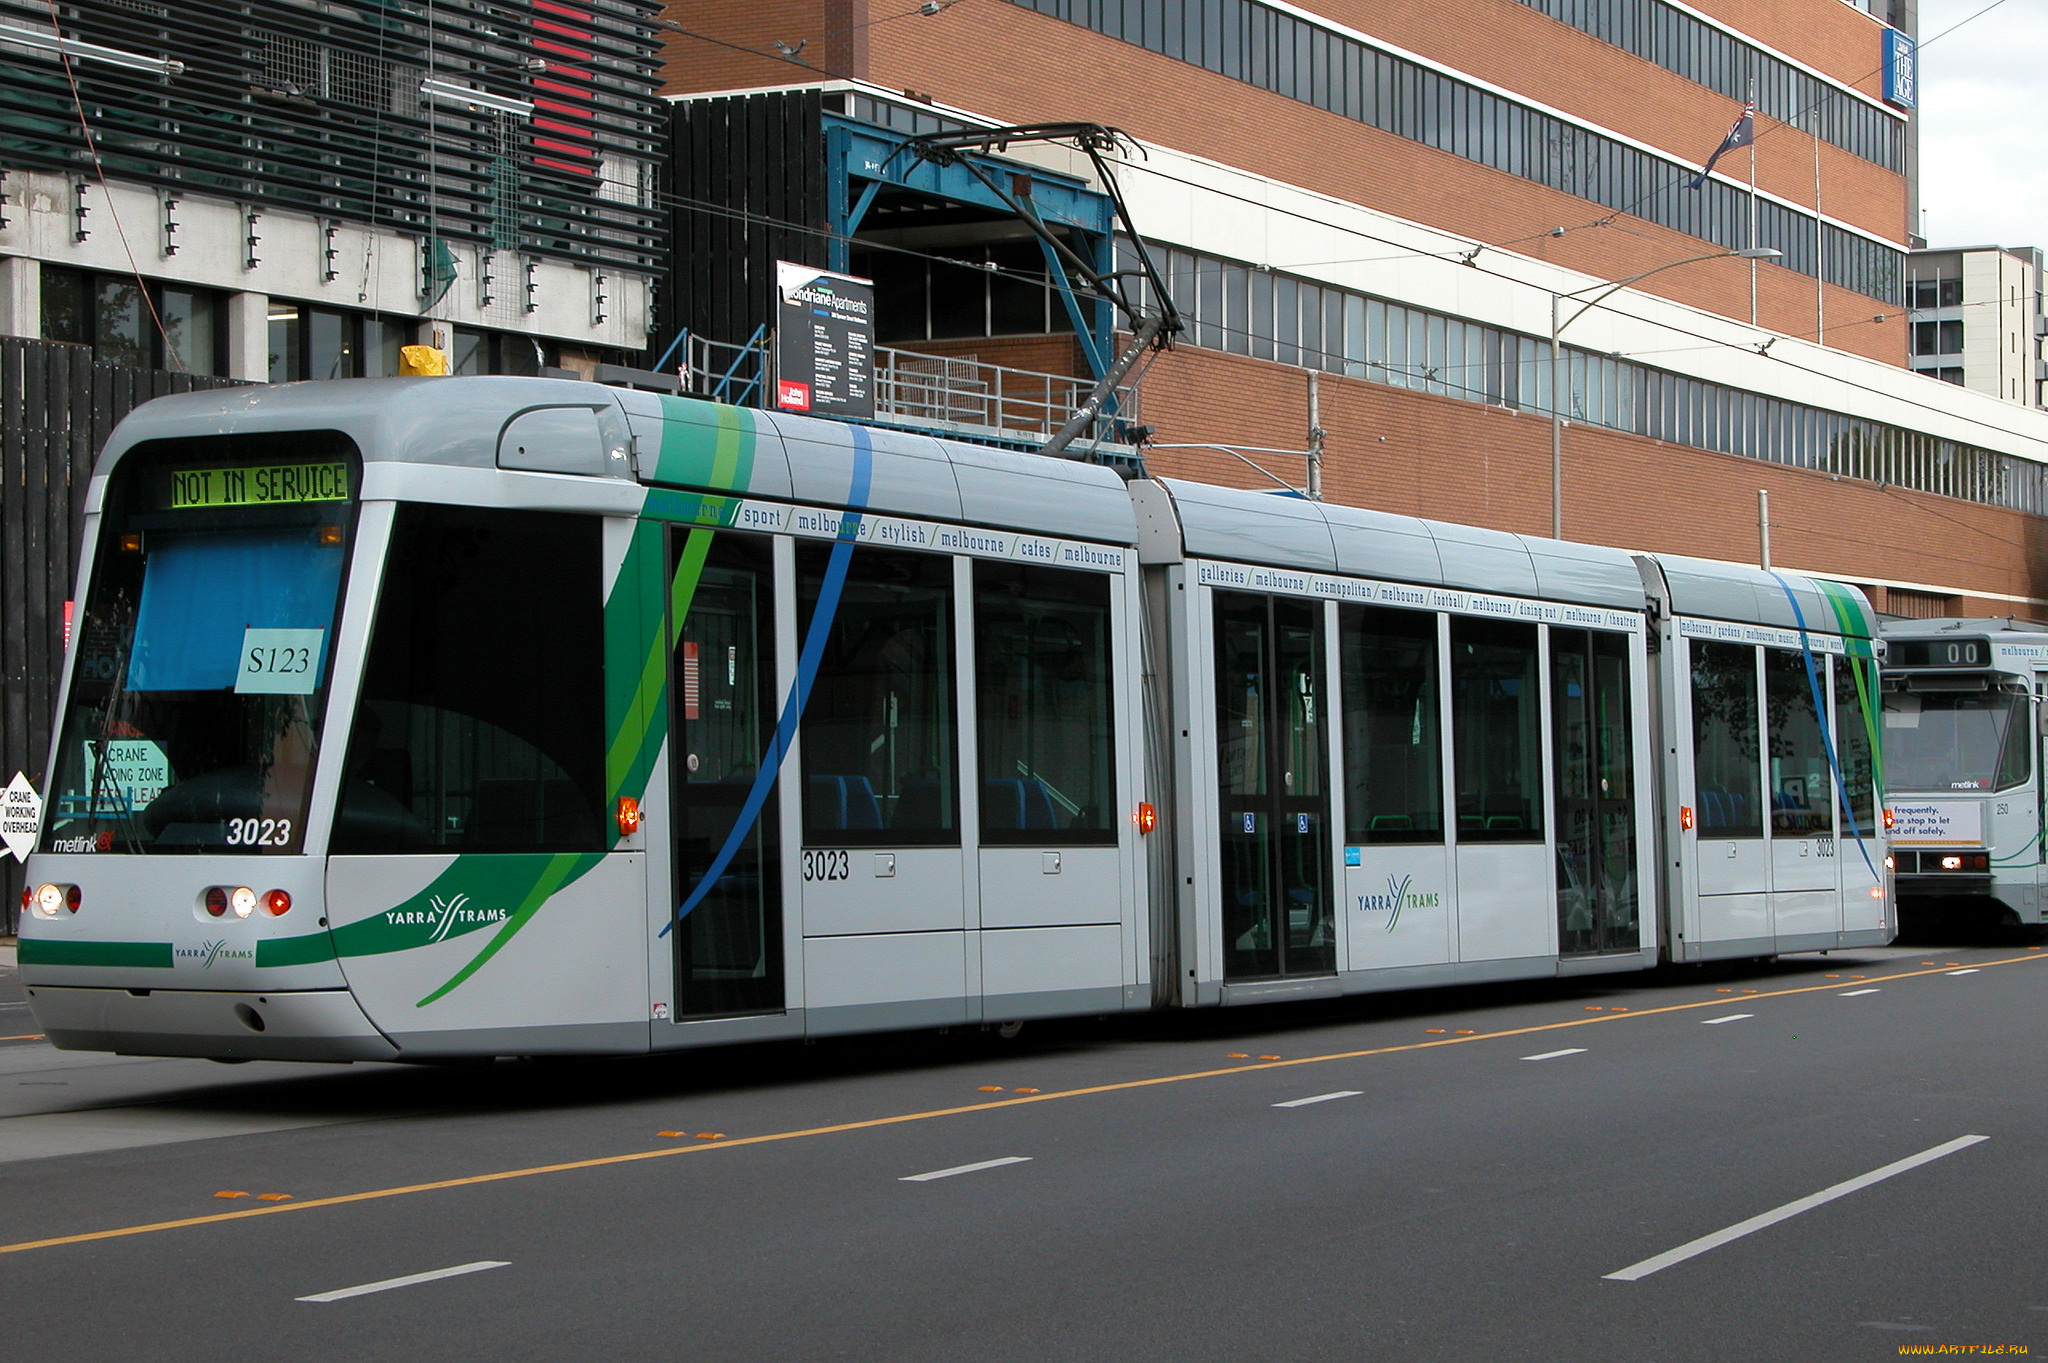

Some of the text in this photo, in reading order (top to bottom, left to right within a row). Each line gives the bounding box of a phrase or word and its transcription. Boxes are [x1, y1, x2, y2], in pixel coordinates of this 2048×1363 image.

[1895, 51, 1913, 80] THE
[1895, 74, 1913, 102] AGE
[832, 293, 868, 315] Apartments
[173, 465, 346, 505] NOT IN SERVICE
[744, 507, 781, 527] sport
[798, 513, 866, 536] melbourne
[881, 523, 926, 544] stylish
[941, 530, 1004, 553] melbourne
[1021, 539, 1051, 558] cafes
[1064, 545, 1121, 566] melbourne
[1200, 565, 1637, 628] galleries melbourne cosmopolitan melbourne football melbourne dining out melbourne theatres
[1681, 619, 1712, 635] melbourne
[1718, 624, 1740, 639] gardens
[1746, 627, 1774, 642] melbourne
[1778, 631, 1794, 645] music
[2001, 645, 2039, 657] melbourne
[247, 647, 309, 673] S123
[108, 747, 147, 762] CRANE
[90, 767, 164, 782] LADING ZONE
[1951, 780, 1980, 789] metlink
[9, 791, 31, 803] CRANE
[5, 806, 36, 819] WORKING
[1894, 805, 1939, 816] frequently.
[1996, 803, 2009, 815] 250
[3, 821, 38, 834] OVERHEAD
[1907, 816, 1925, 826] stop
[1928, 815, 1937, 825] to
[1939, 815, 1950, 825] let
[227, 818, 292, 846] 3023
[1903, 825, 1916, 835] off
[1918, 826, 1946, 837] safely.
[53, 832, 97, 853] metlink
[1816, 838, 1835, 857] 3023
[803, 850, 849, 881] 3023
[1358, 893, 1439, 911] YARRA TRAMS
[386, 908, 506, 925] YARRA TRAMS
[175, 947, 253, 960] YARRA TRAMS
